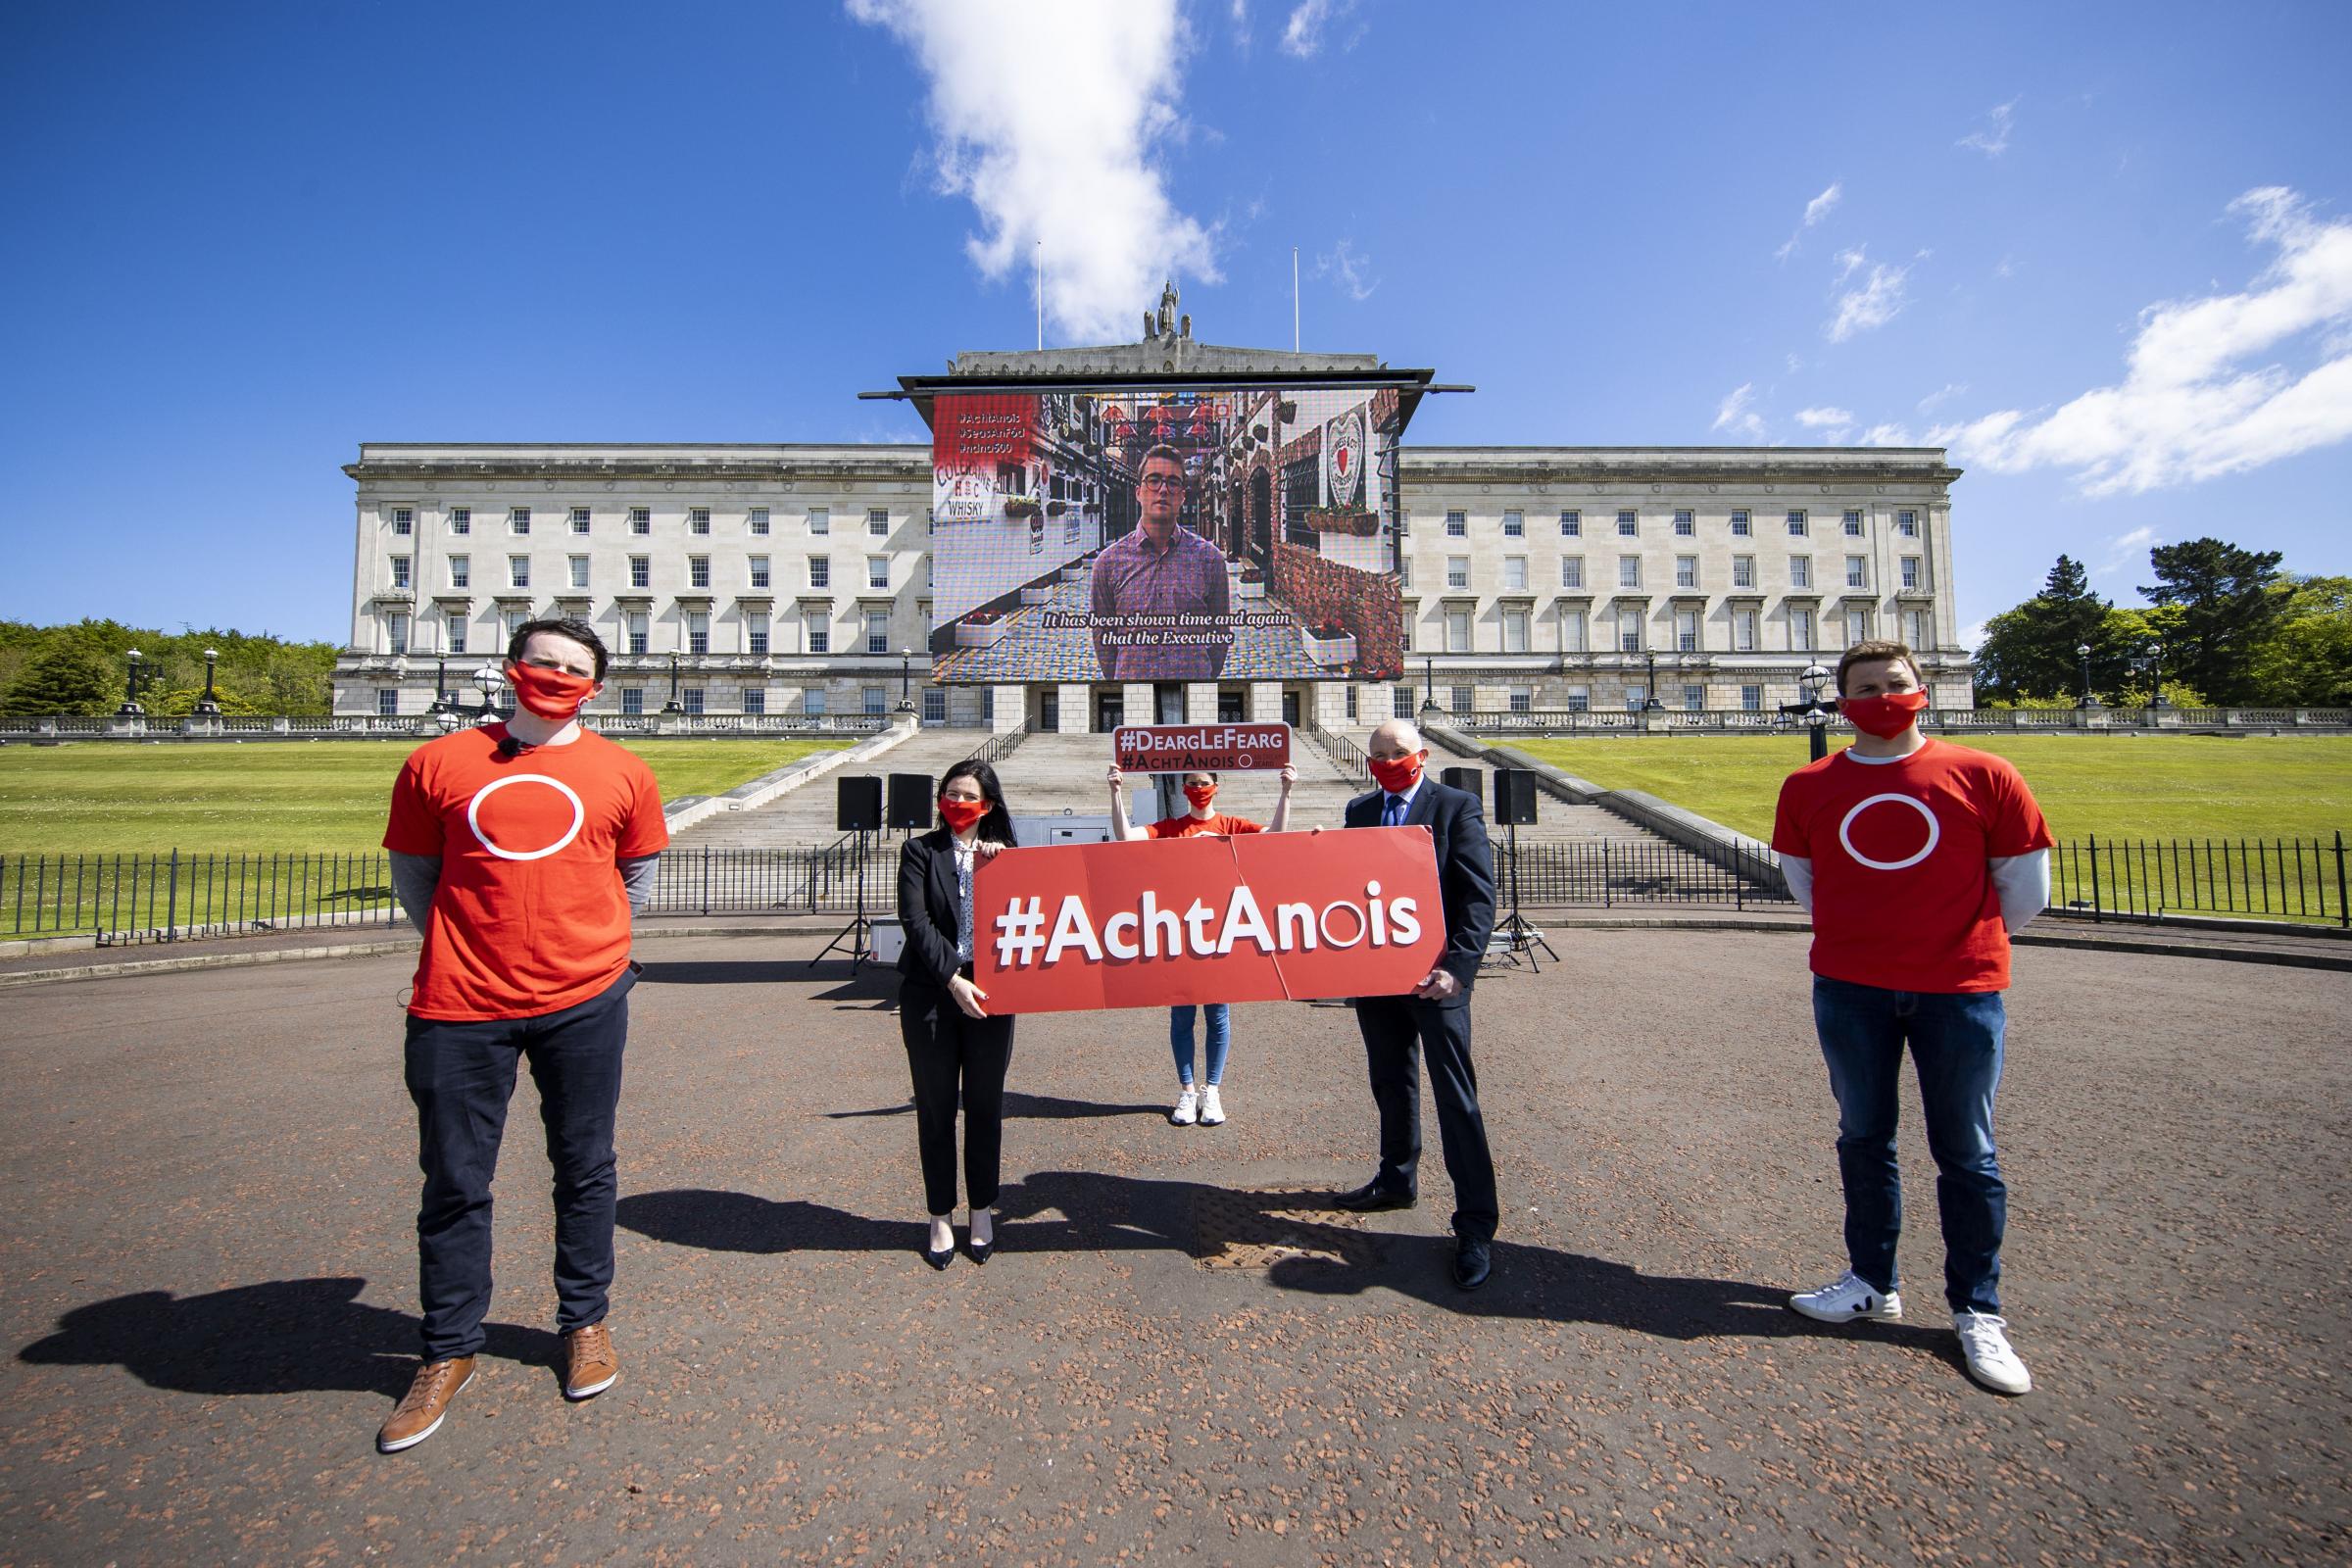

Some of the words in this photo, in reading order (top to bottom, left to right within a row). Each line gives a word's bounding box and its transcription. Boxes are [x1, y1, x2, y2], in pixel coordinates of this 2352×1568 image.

[949, 501, 984, 515] WHISKY
[1045, 613, 1057, 627] It
[1060, 612, 1087, 627] has
[1090, 612, 1124, 626] been
[1127, 612, 1175, 626] shown
[1180, 612, 1212, 626] time
[1215, 612, 1244, 625] and
[1247, 612, 1290, 628] again
[1102, 632, 1133, 645] that
[1136, 631, 1159, 645] the
[1162, 630, 1233, 645] Executive
[996, 880, 1422, 967] #AchtAnois
